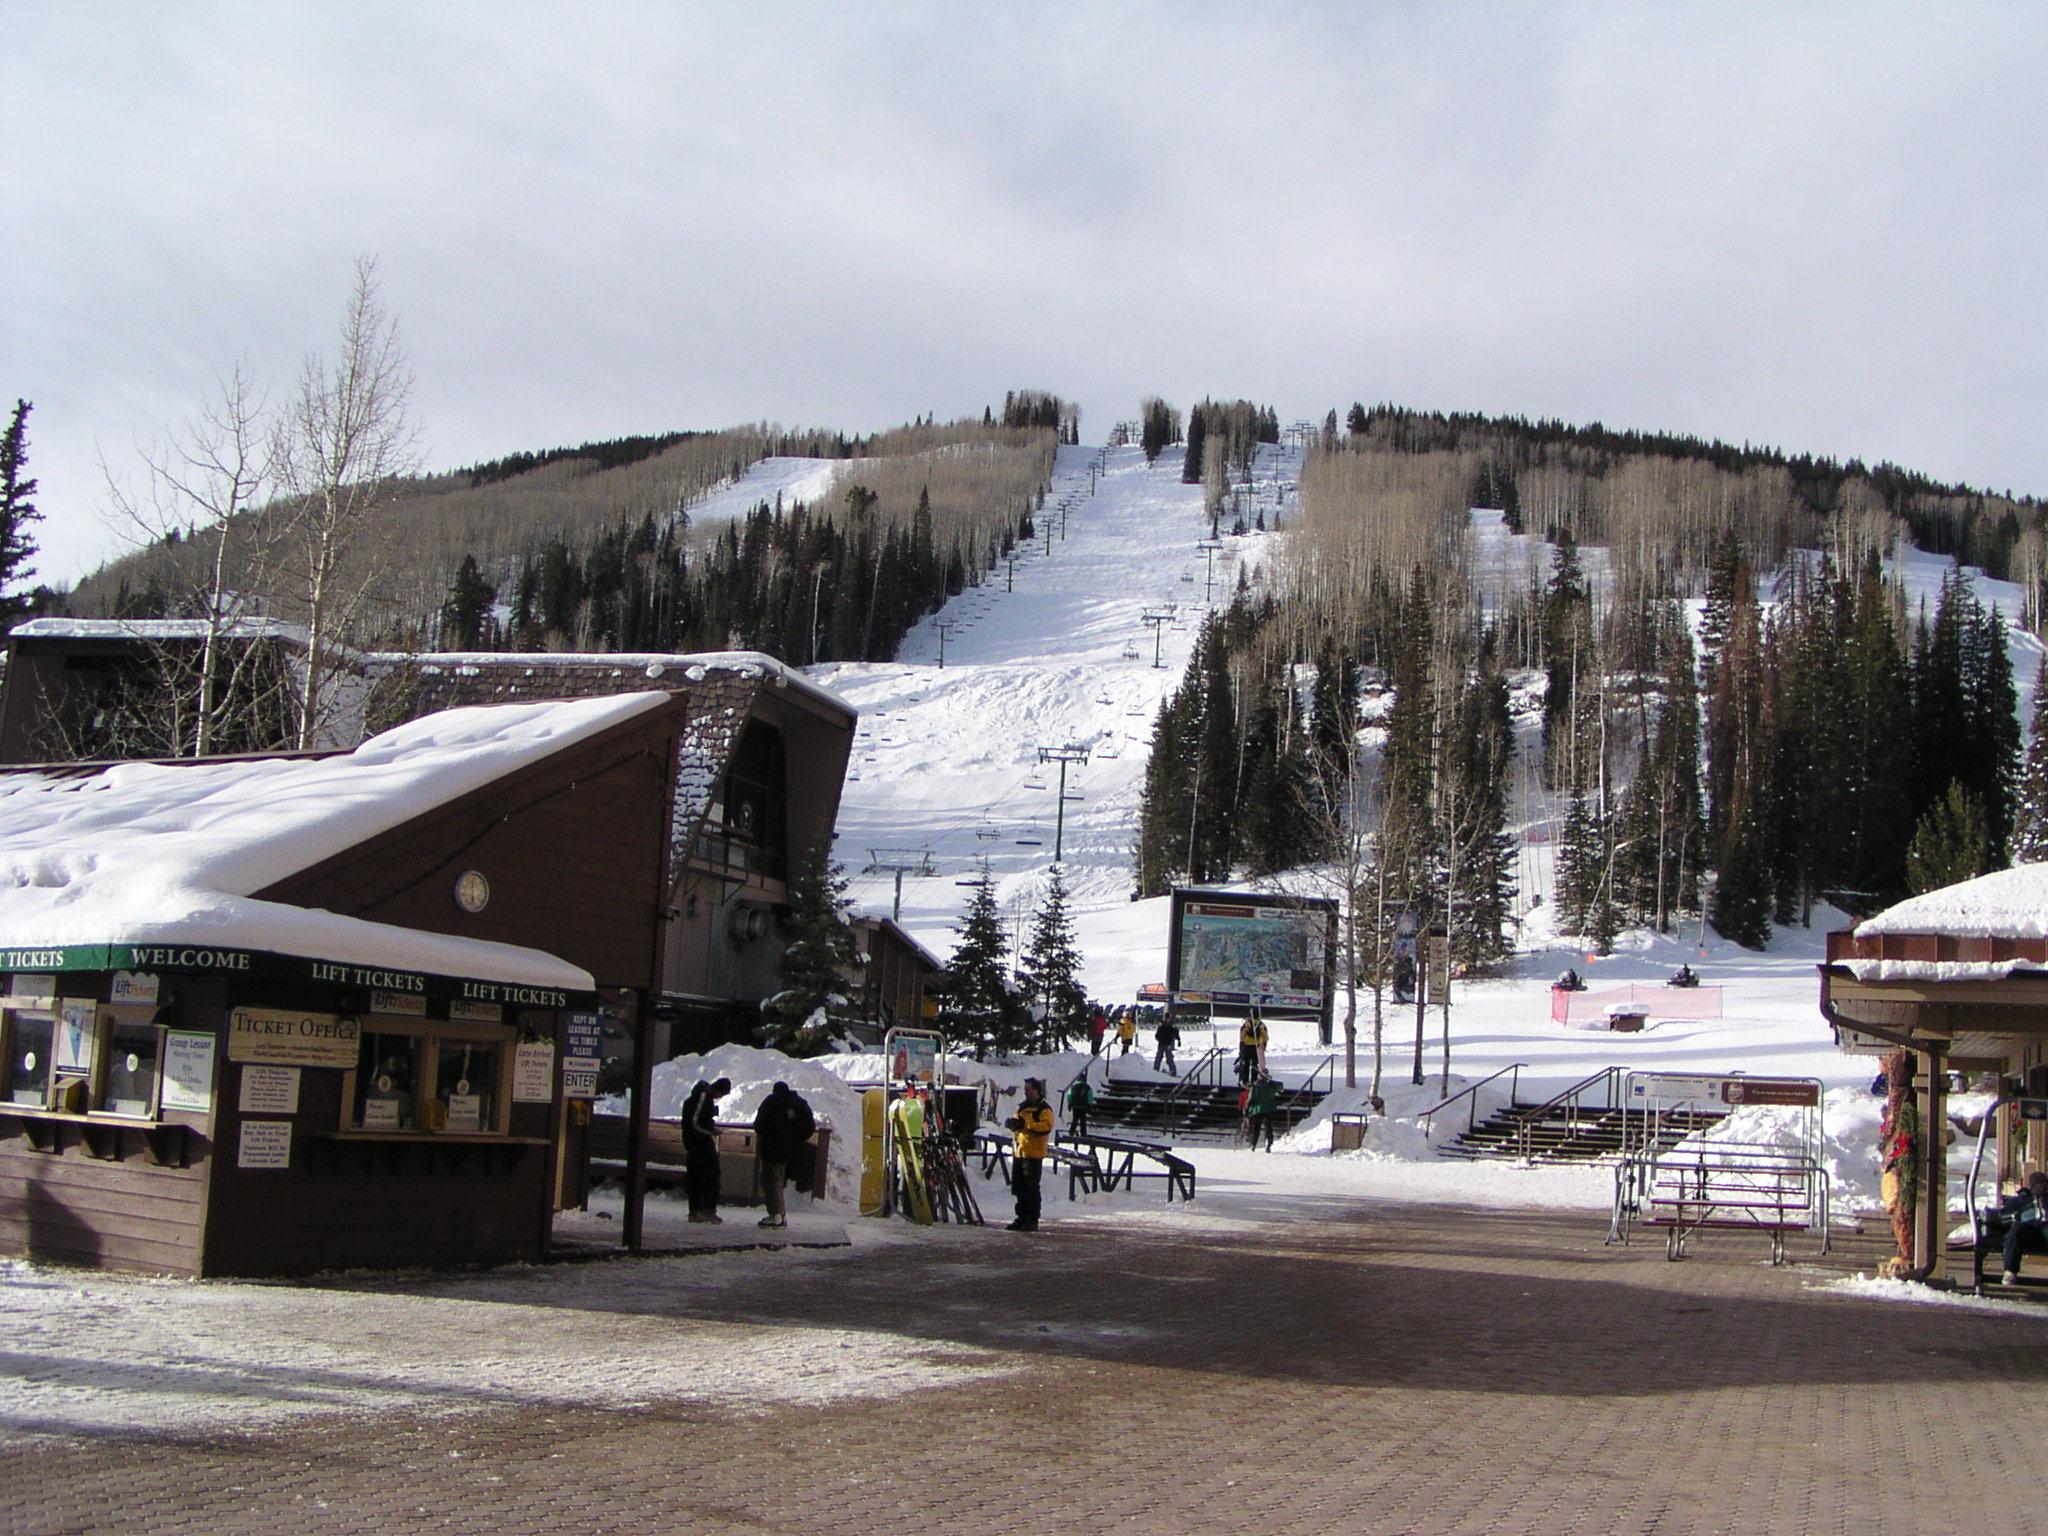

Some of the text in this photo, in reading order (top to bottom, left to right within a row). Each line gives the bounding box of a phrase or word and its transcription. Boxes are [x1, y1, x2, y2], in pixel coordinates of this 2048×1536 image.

[7, 950, 64, 968] TICKETS
[131, 948, 250, 970] WELCOME
[311, 962, 424, 992] LIFT TICKETS
[463, 982, 566, 1007] LIFT TICKETS
[569, 1036, 579, 1046] ALL
[565, 1073, 596, 1088] ENTER
